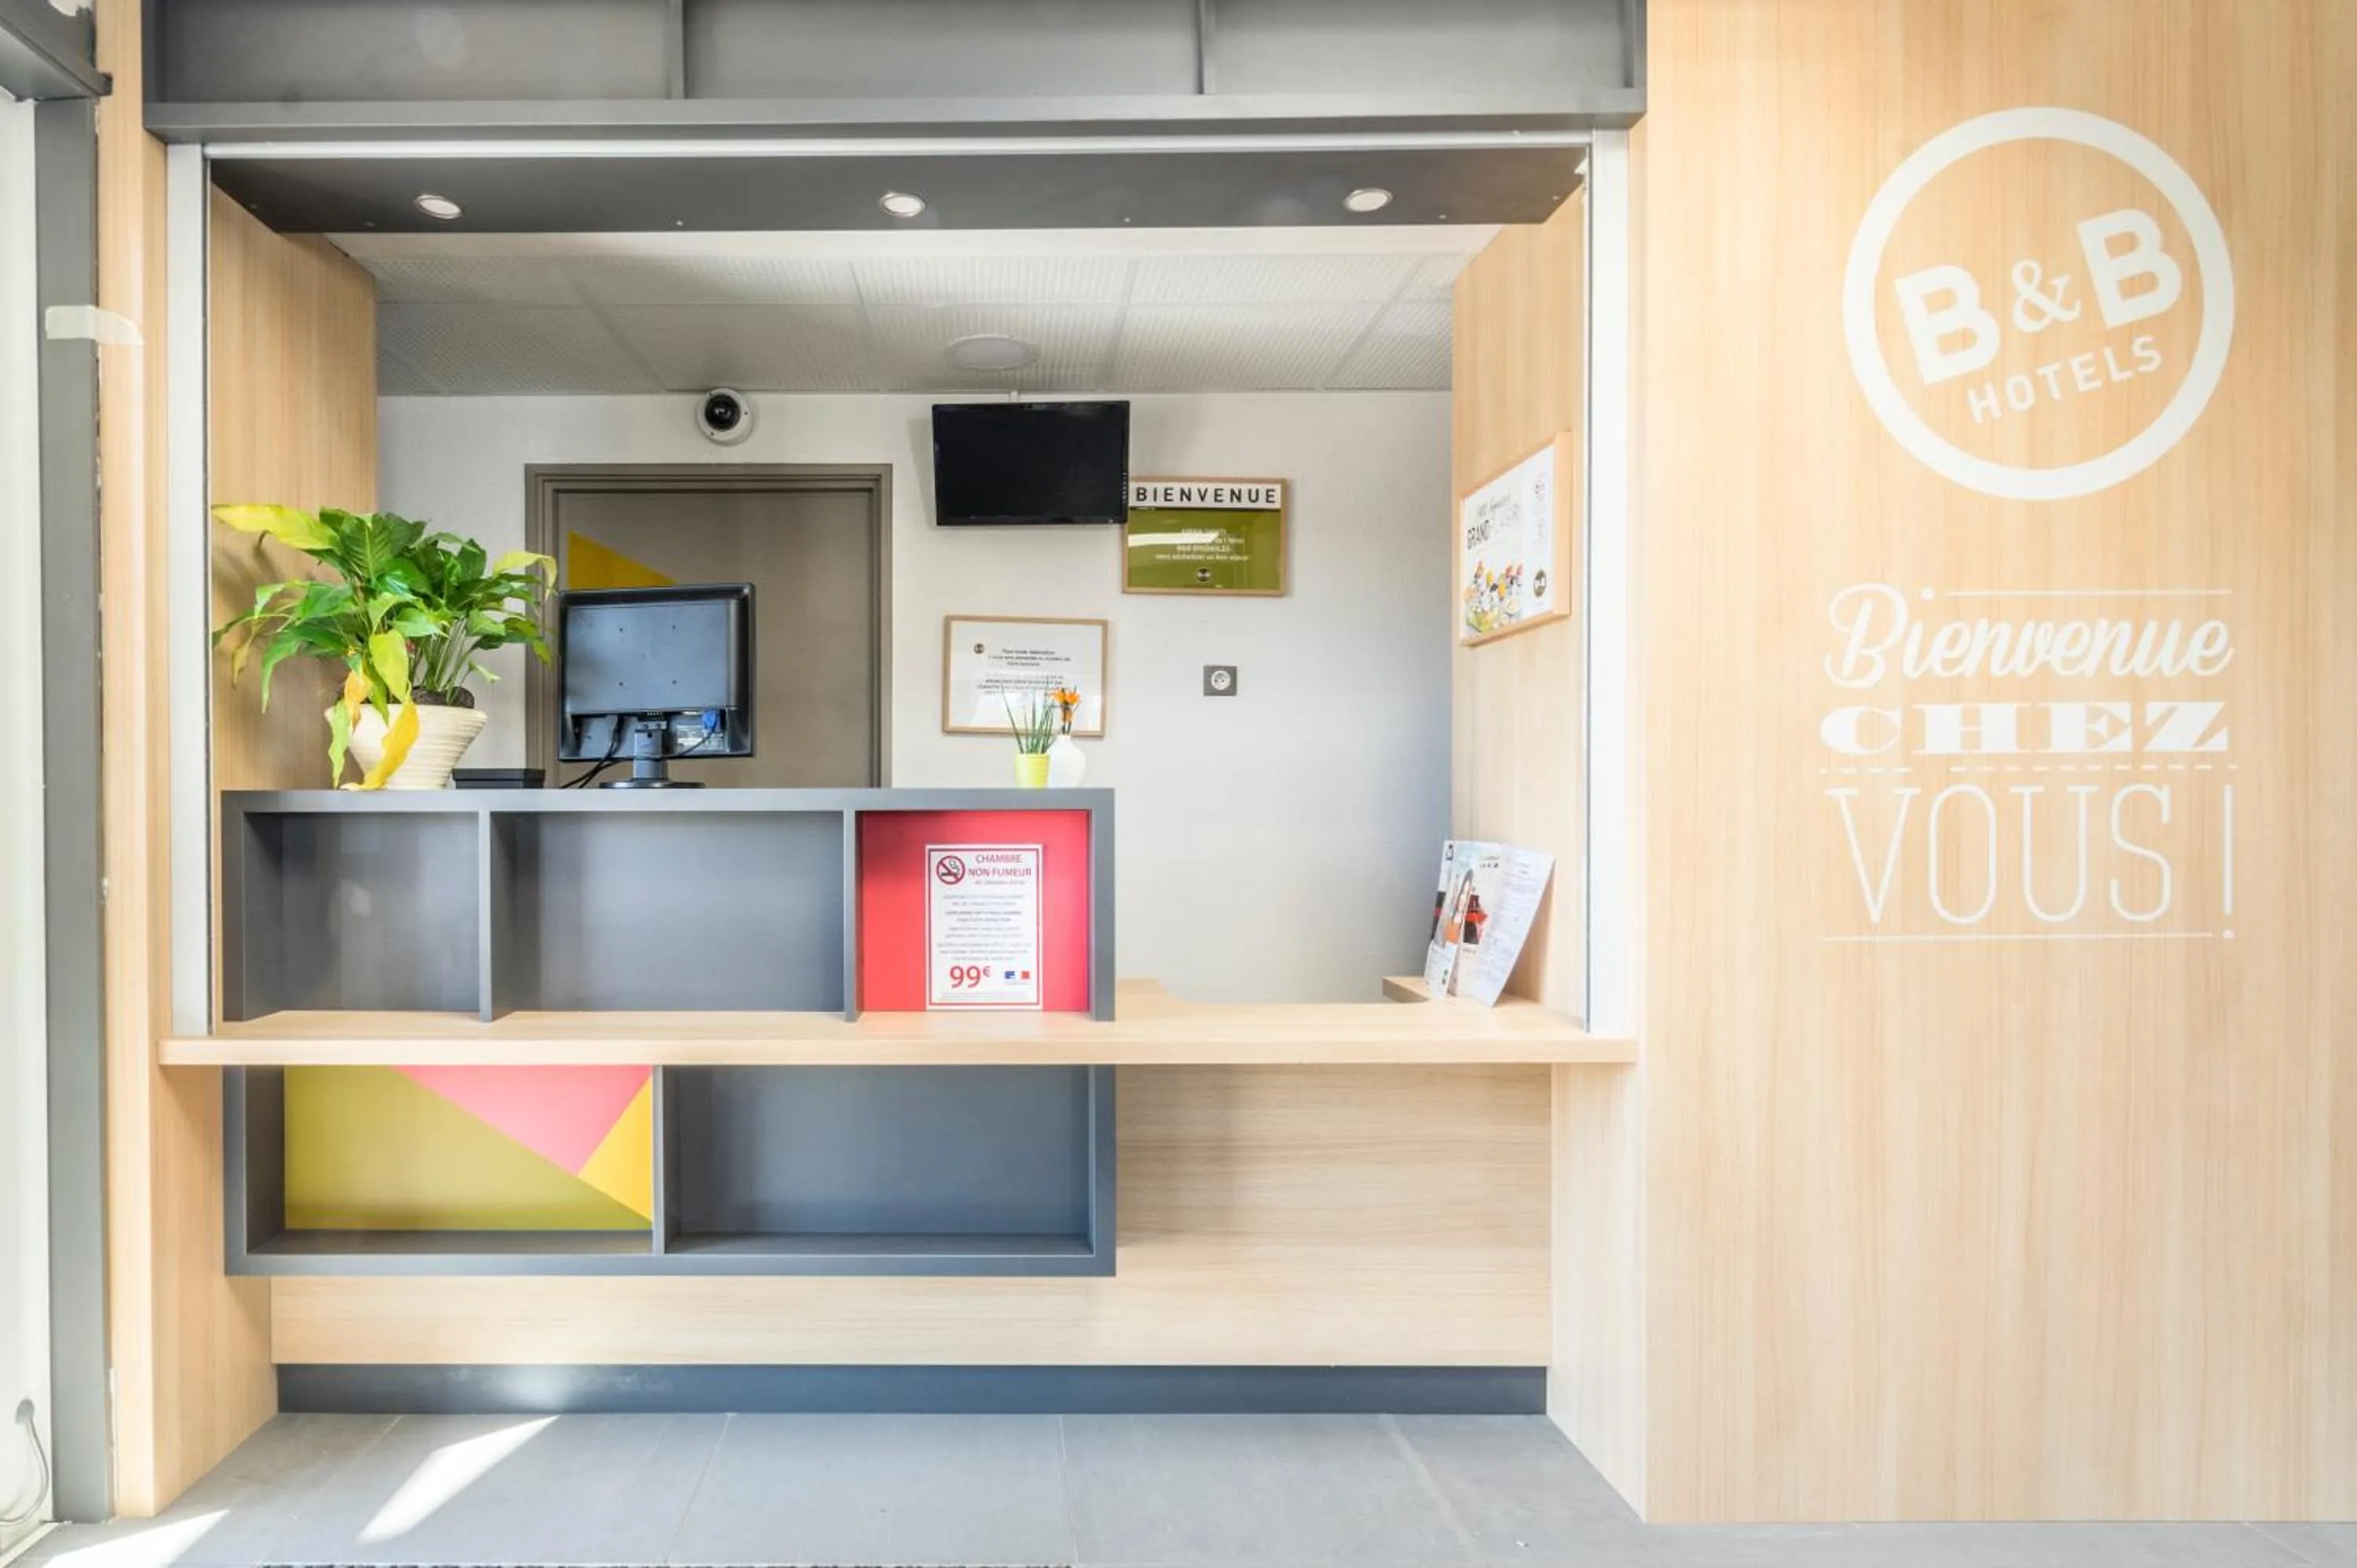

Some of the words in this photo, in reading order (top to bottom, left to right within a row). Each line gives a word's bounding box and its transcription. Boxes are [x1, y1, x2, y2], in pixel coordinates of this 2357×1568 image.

[1894, 208, 2183, 385] B&B
[1966, 336, 2162, 424] HOTELS
[1136, 487, 1277, 504] BIENVENUE
[1824, 583, 2235, 689] Bienvenue
[1820, 702, 2228, 756] CHEZ
[968, 867, 990, 877] NON
[992, 867, 1032, 877] FUMEUR
[975, 854, 1023, 863] CHAMBRE
